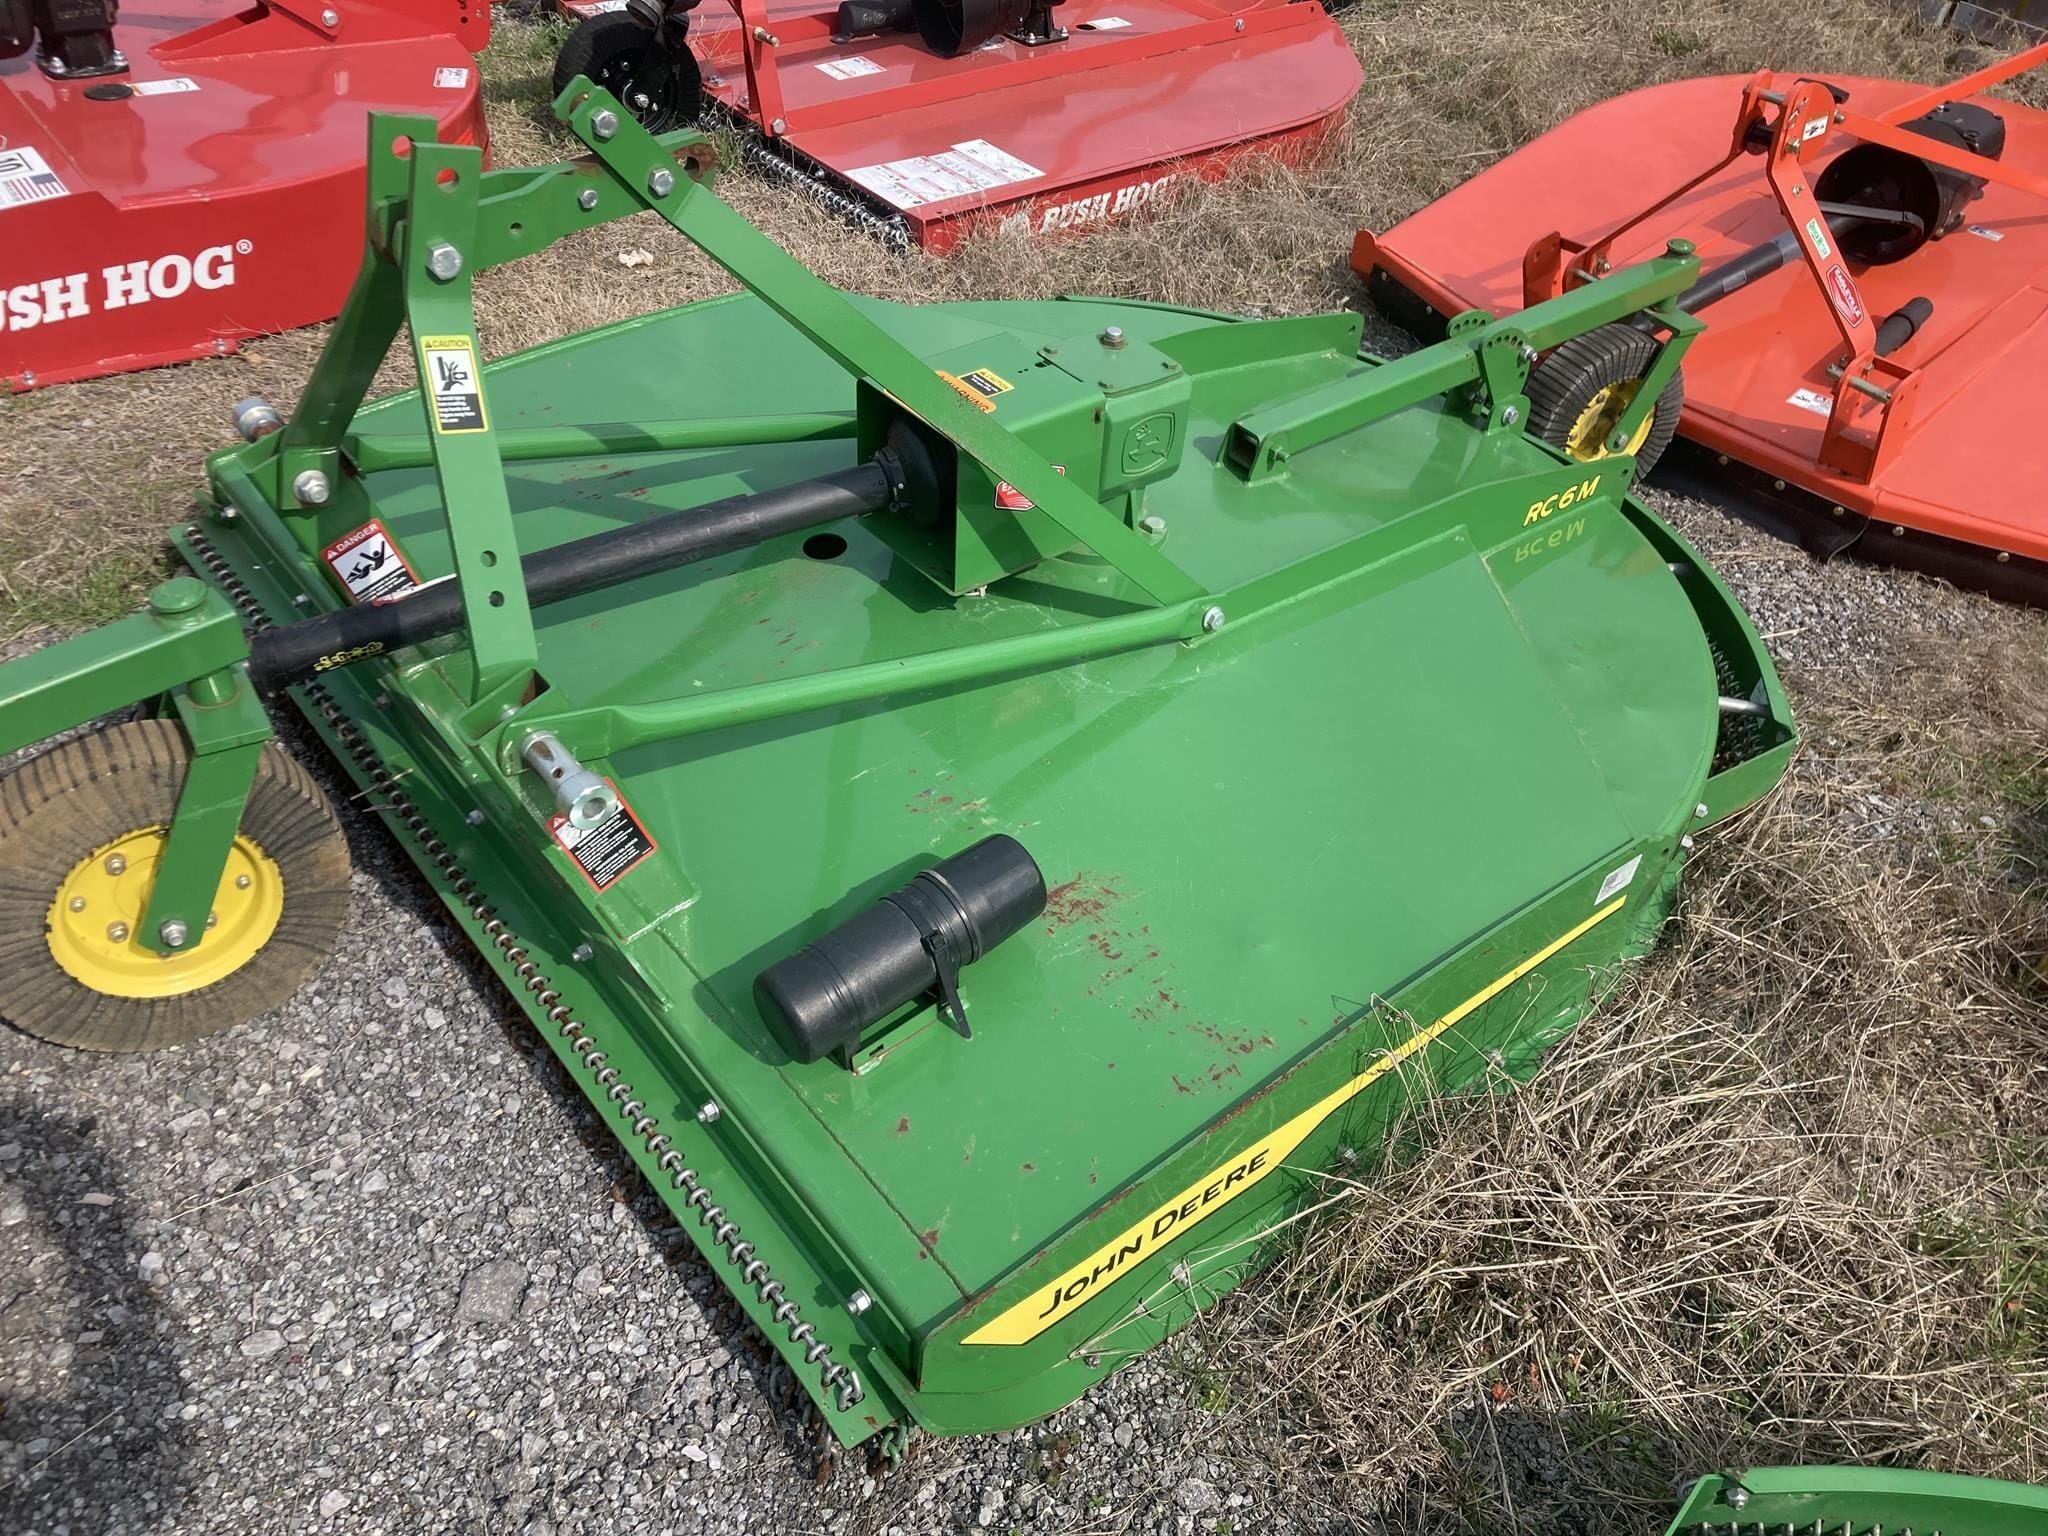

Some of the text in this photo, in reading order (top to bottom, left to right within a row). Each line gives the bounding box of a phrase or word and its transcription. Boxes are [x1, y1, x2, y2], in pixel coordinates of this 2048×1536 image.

[1523, 473, 1602, 527] RC6M
[335, 523, 379, 551] DANGER
[1039, 1148, 1270, 1320] JOHN DEERE
